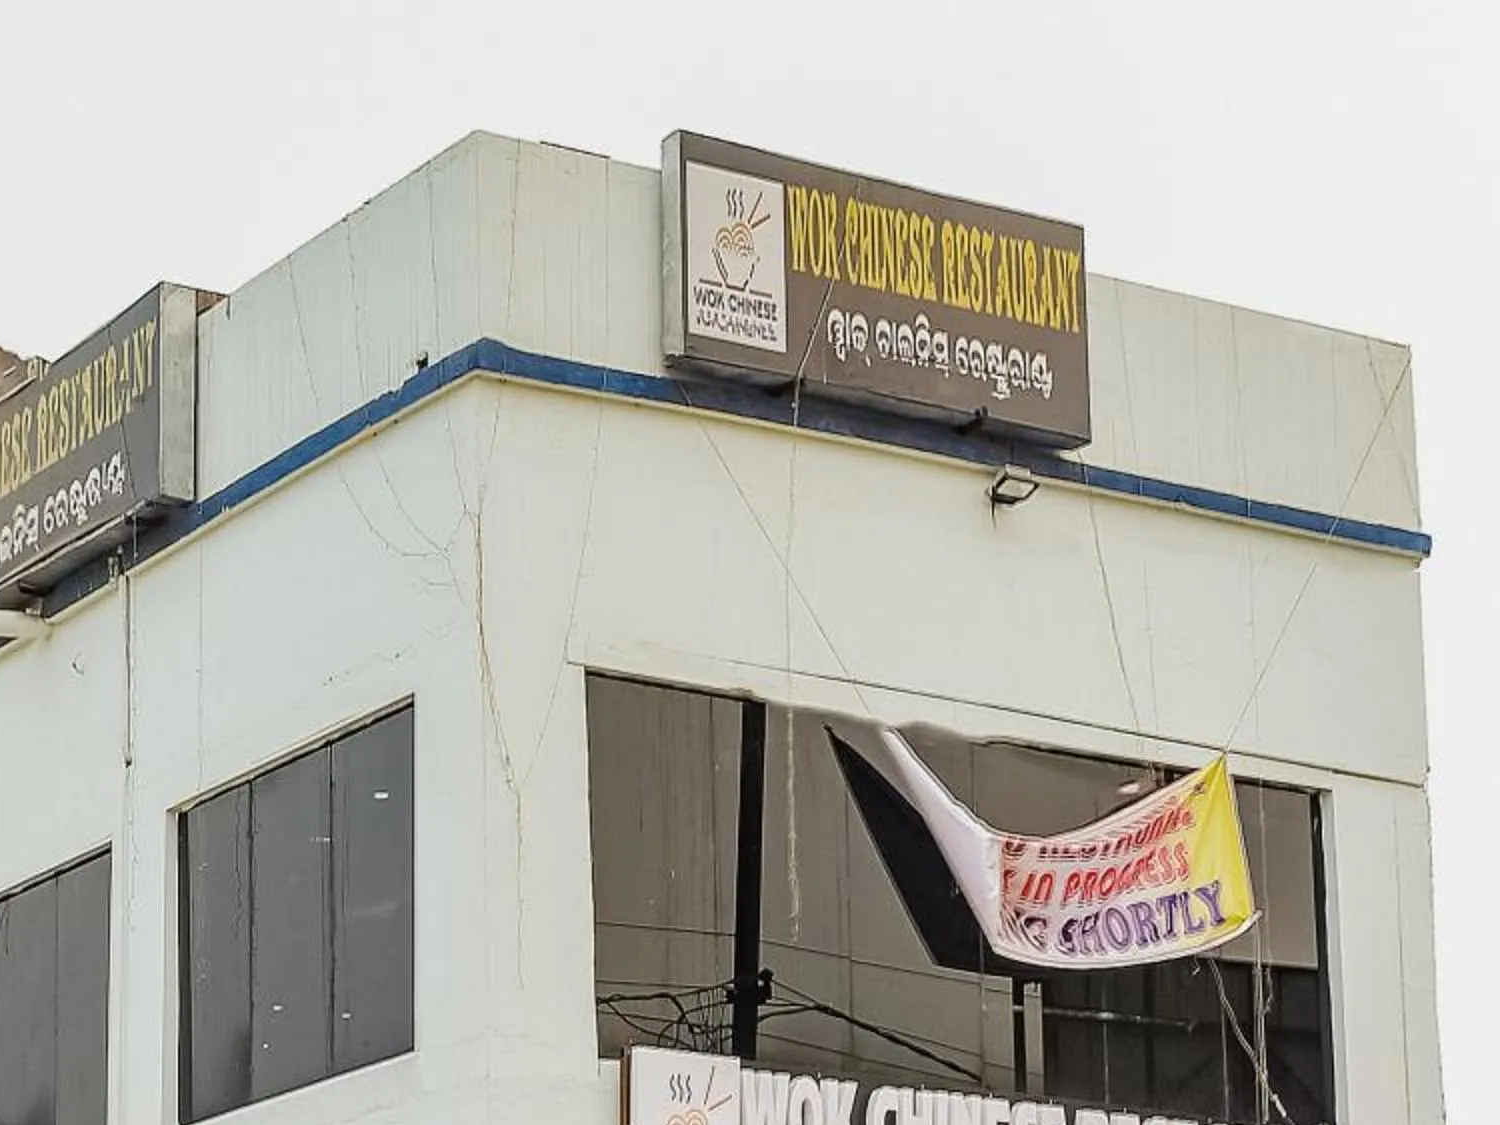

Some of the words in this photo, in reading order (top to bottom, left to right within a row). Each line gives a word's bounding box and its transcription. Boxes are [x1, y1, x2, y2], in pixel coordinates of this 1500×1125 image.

[786, 184, 841, 281] WOK
[844, 196, 936, 300] CHINESE
[37, 316, 157, 473] RESTAURANT
[1020, 869, 1055, 906] IN
[1062, 841, 1190, 907] PROGRESS
[1056, 879, 1227, 957] SHORTLY
